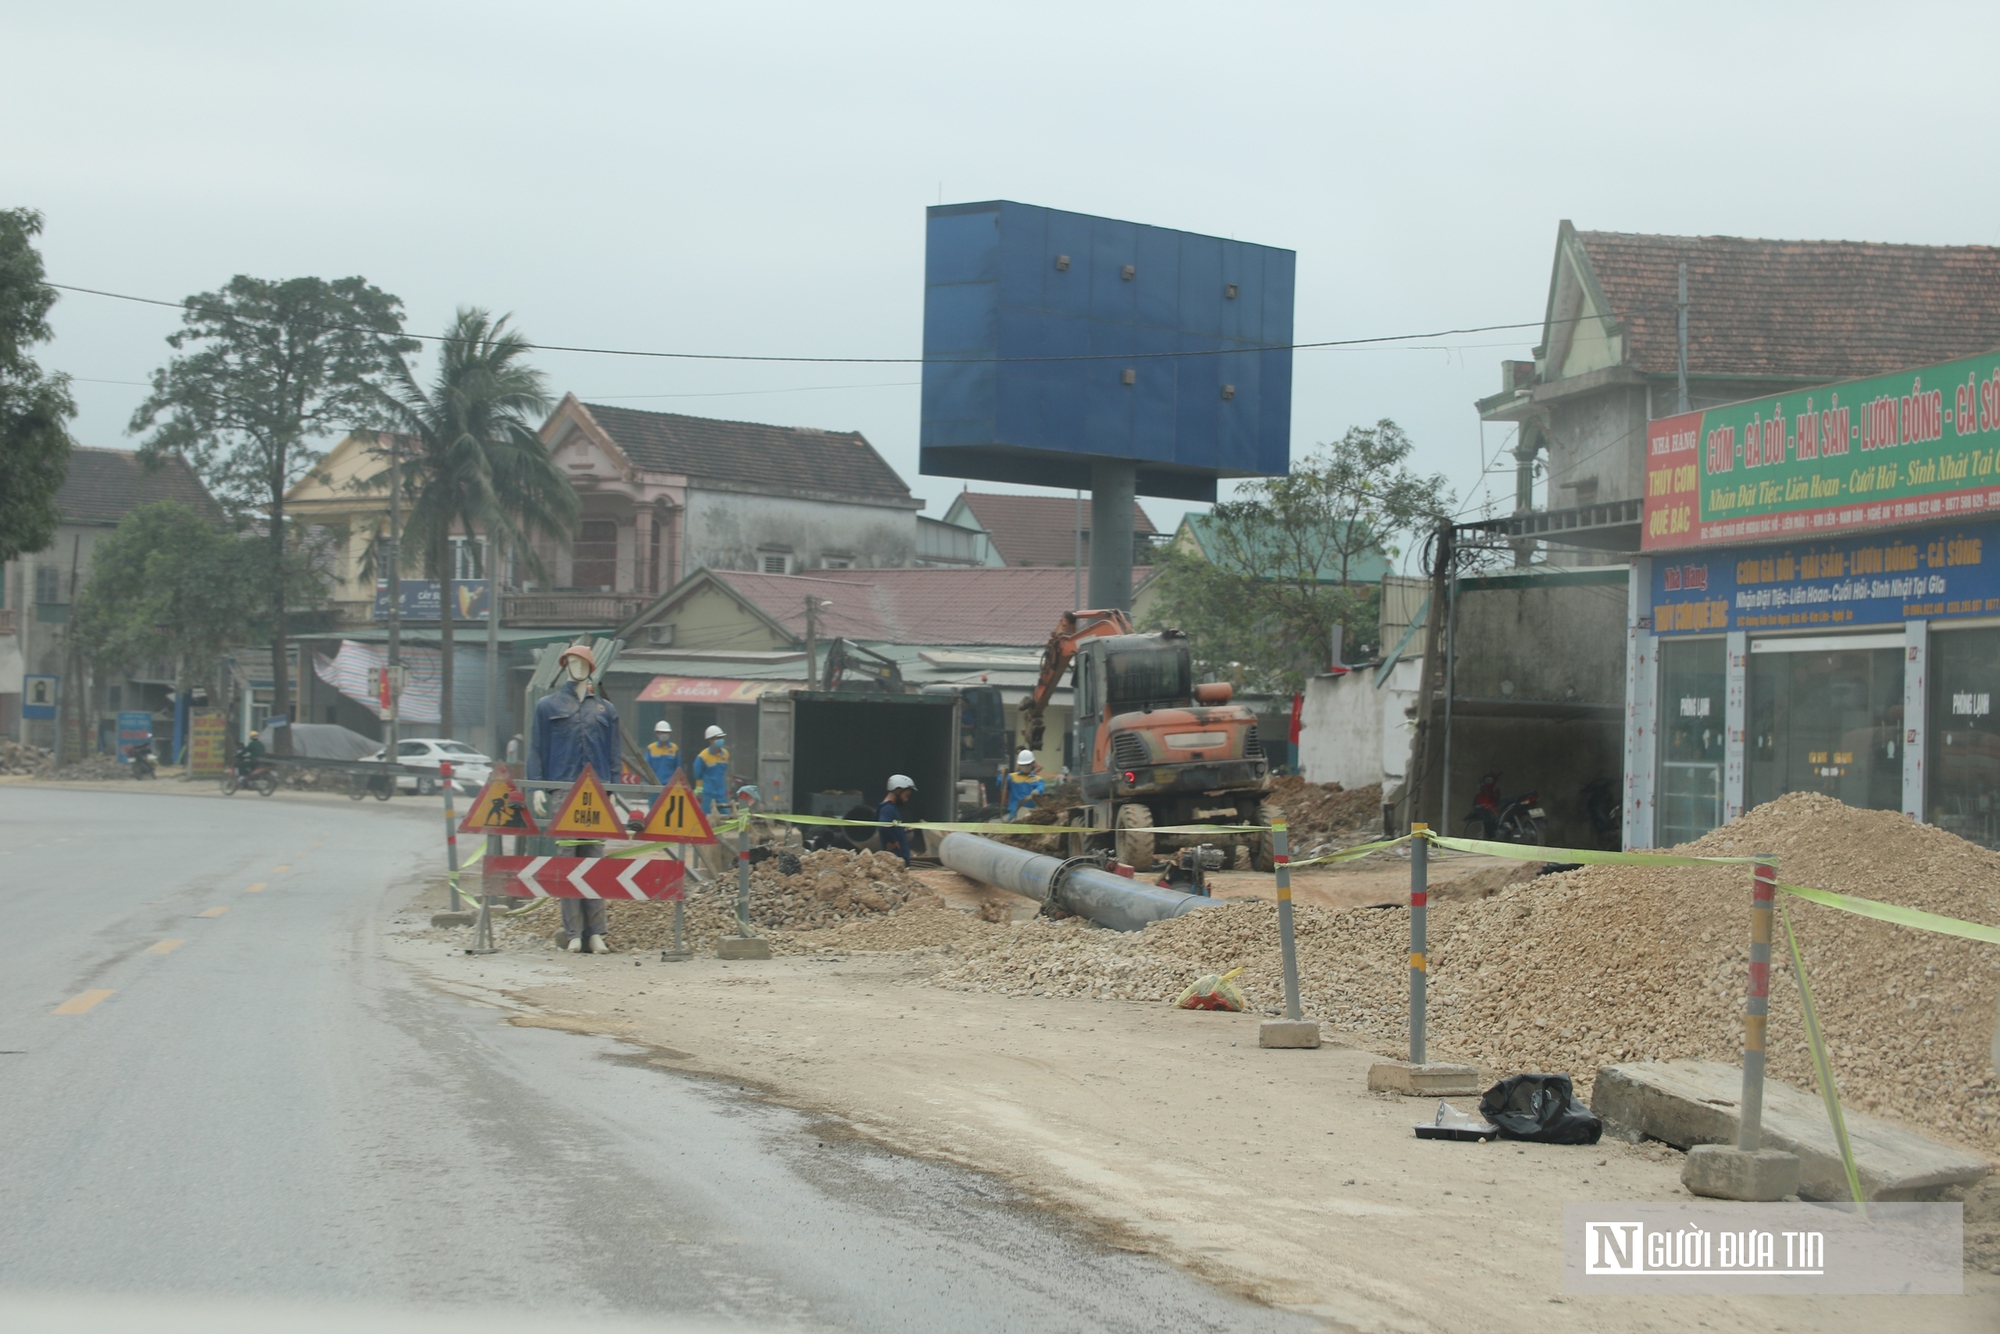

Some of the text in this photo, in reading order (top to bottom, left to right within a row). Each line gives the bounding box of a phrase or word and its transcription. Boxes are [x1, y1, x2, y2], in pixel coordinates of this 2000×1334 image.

[1706, 424, 1734, 475] CƠM
[1744, 412, 1761, 469] GÀ
[1796, 397, 1819, 461] HẢI
[1821, 393, 1849, 457] SẢN
[1861, 394, 1898, 451] LƯƠN
[1956, 372, 1977, 436] CÁ
[1652, 429, 1696, 455] NHÀ HÀNG
[1649, 464, 1696, 497] THÚY CƠM
[1708, 486, 1736, 516] Nhận
[1737, 484, 1757, 513] Đặt
[1759, 480, 1784, 510] Tiệc:
[1785, 476, 1809, 502] Liên
[1810, 474, 1840, 499] Hoan
[1849, 466, 1875, 494] Cưới
[1876, 462, 1898, 490] Hỏi
[1907, 458, 1935, 487] Sinh
[1937, 452, 1969, 486] Nhật
[1972, 448, 1994, 483] Tại
[1649, 502, 1690, 538] QUÊ BÁC
[1801, 547, 1819, 580] HẢI
[1821, 545, 1844, 578] SẢN
[1850, 547, 1883, 576] LƯƠN
[1927, 536, 1945, 568] CÁ
[1947, 533, 1982, 566] SÔNG
[1664, 563, 1707, 591] Nhà Hàng
[1735, 590, 1756, 611] Nhận
[1952, 689, 1990, 717] PHÒNG LẠNH
[582, 791, 592, 806] ĐI
